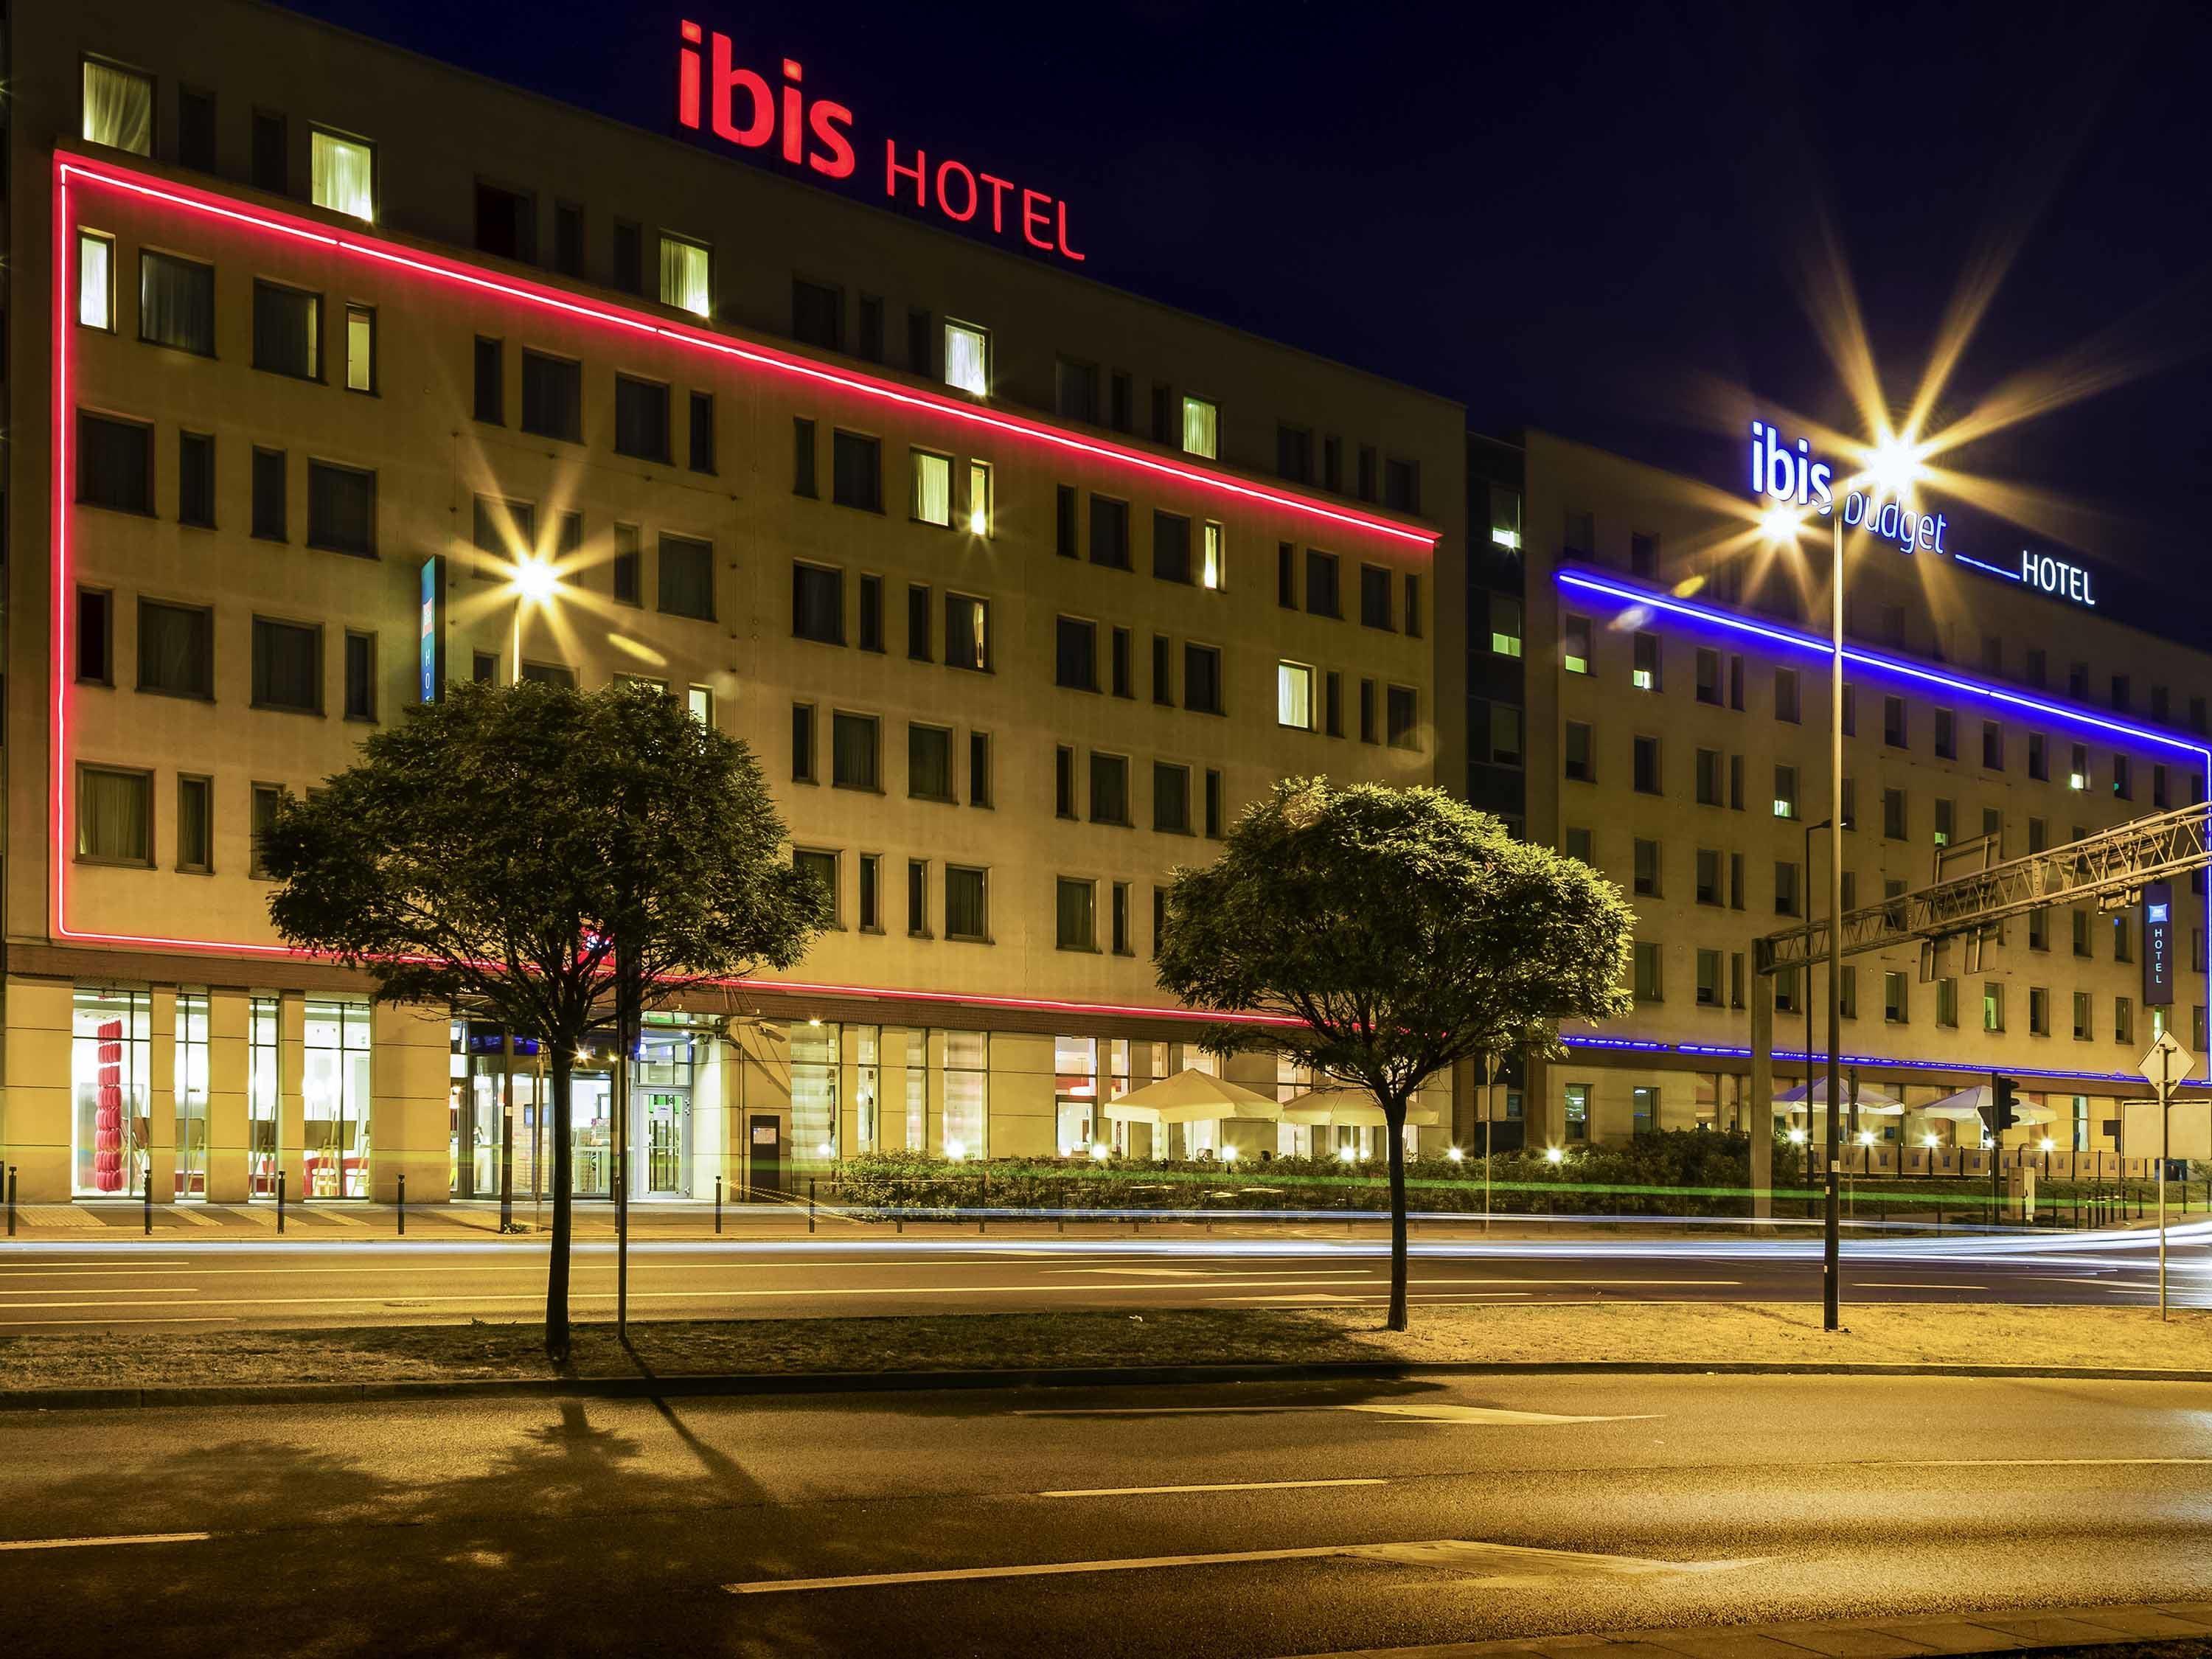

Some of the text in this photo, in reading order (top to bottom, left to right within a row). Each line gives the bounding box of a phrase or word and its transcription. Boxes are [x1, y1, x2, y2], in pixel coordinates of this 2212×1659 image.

[680, 19, 1085, 261] ibis HOTEL
[1752, 420, 1833, 515] ibis
[2023, 550, 2096, 605] HOTEL
[2154, 929, 2163, 984] HOTEL
